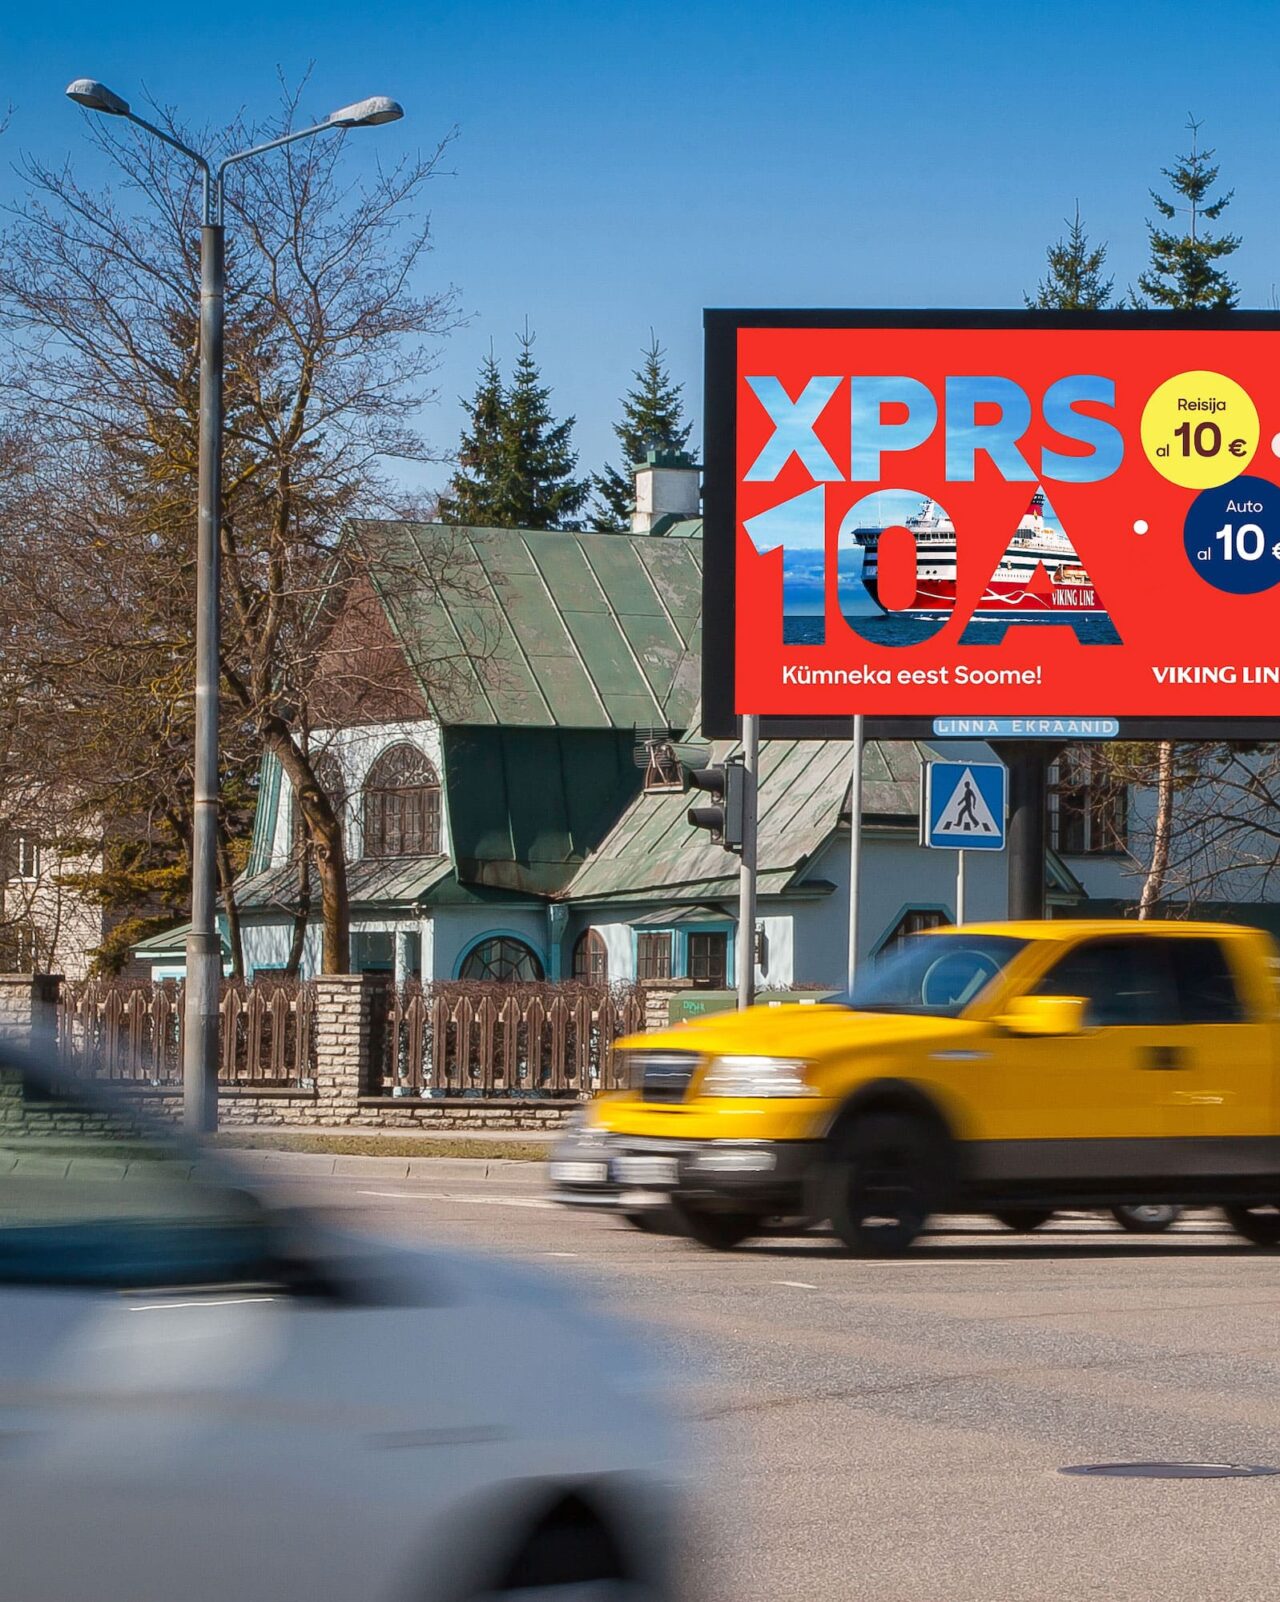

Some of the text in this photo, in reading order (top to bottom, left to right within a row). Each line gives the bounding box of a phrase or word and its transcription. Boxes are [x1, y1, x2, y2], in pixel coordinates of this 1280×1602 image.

[1178, 398, 1225, 414] Reisija
[742, 374, 1125, 482] XPRS
[1156, 422, 1246, 457] al 10 €
[1226, 500, 1264, 513] Auto
[1197, 546, 1210, 560] al
[1216, 524, 1264, 560] 10
[742, 484, 1124, 649] 10A
[1052, 590, 1095, 607] VIKING LINE
[782, 665, 1042, 685] Kümneka eest Soome!
[1151, 666, 1236, 684] VIKING
[937, 719, 1114, 733] LINNA EKRAANID
